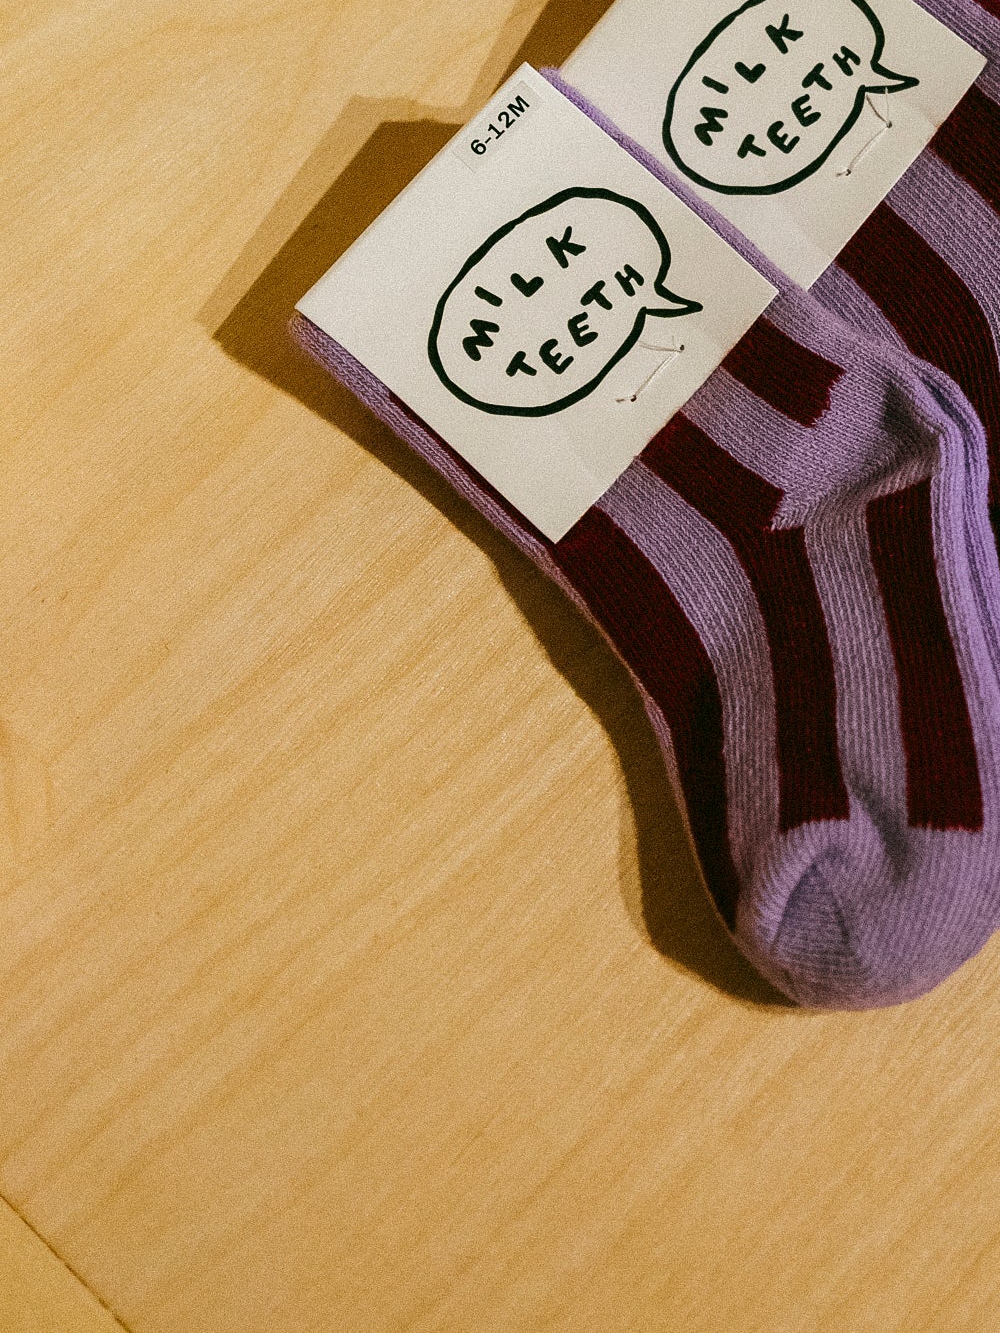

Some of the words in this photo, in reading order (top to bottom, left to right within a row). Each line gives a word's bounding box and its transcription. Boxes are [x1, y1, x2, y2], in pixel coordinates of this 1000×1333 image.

[470, 95, 530, 156] 6-12M
[694, 13, 804, 146] MILK
[737, 45, 861, 159] TEETH
[462, 226, 587, 361] MILK
[505, 264, 645, 377] TEETH
